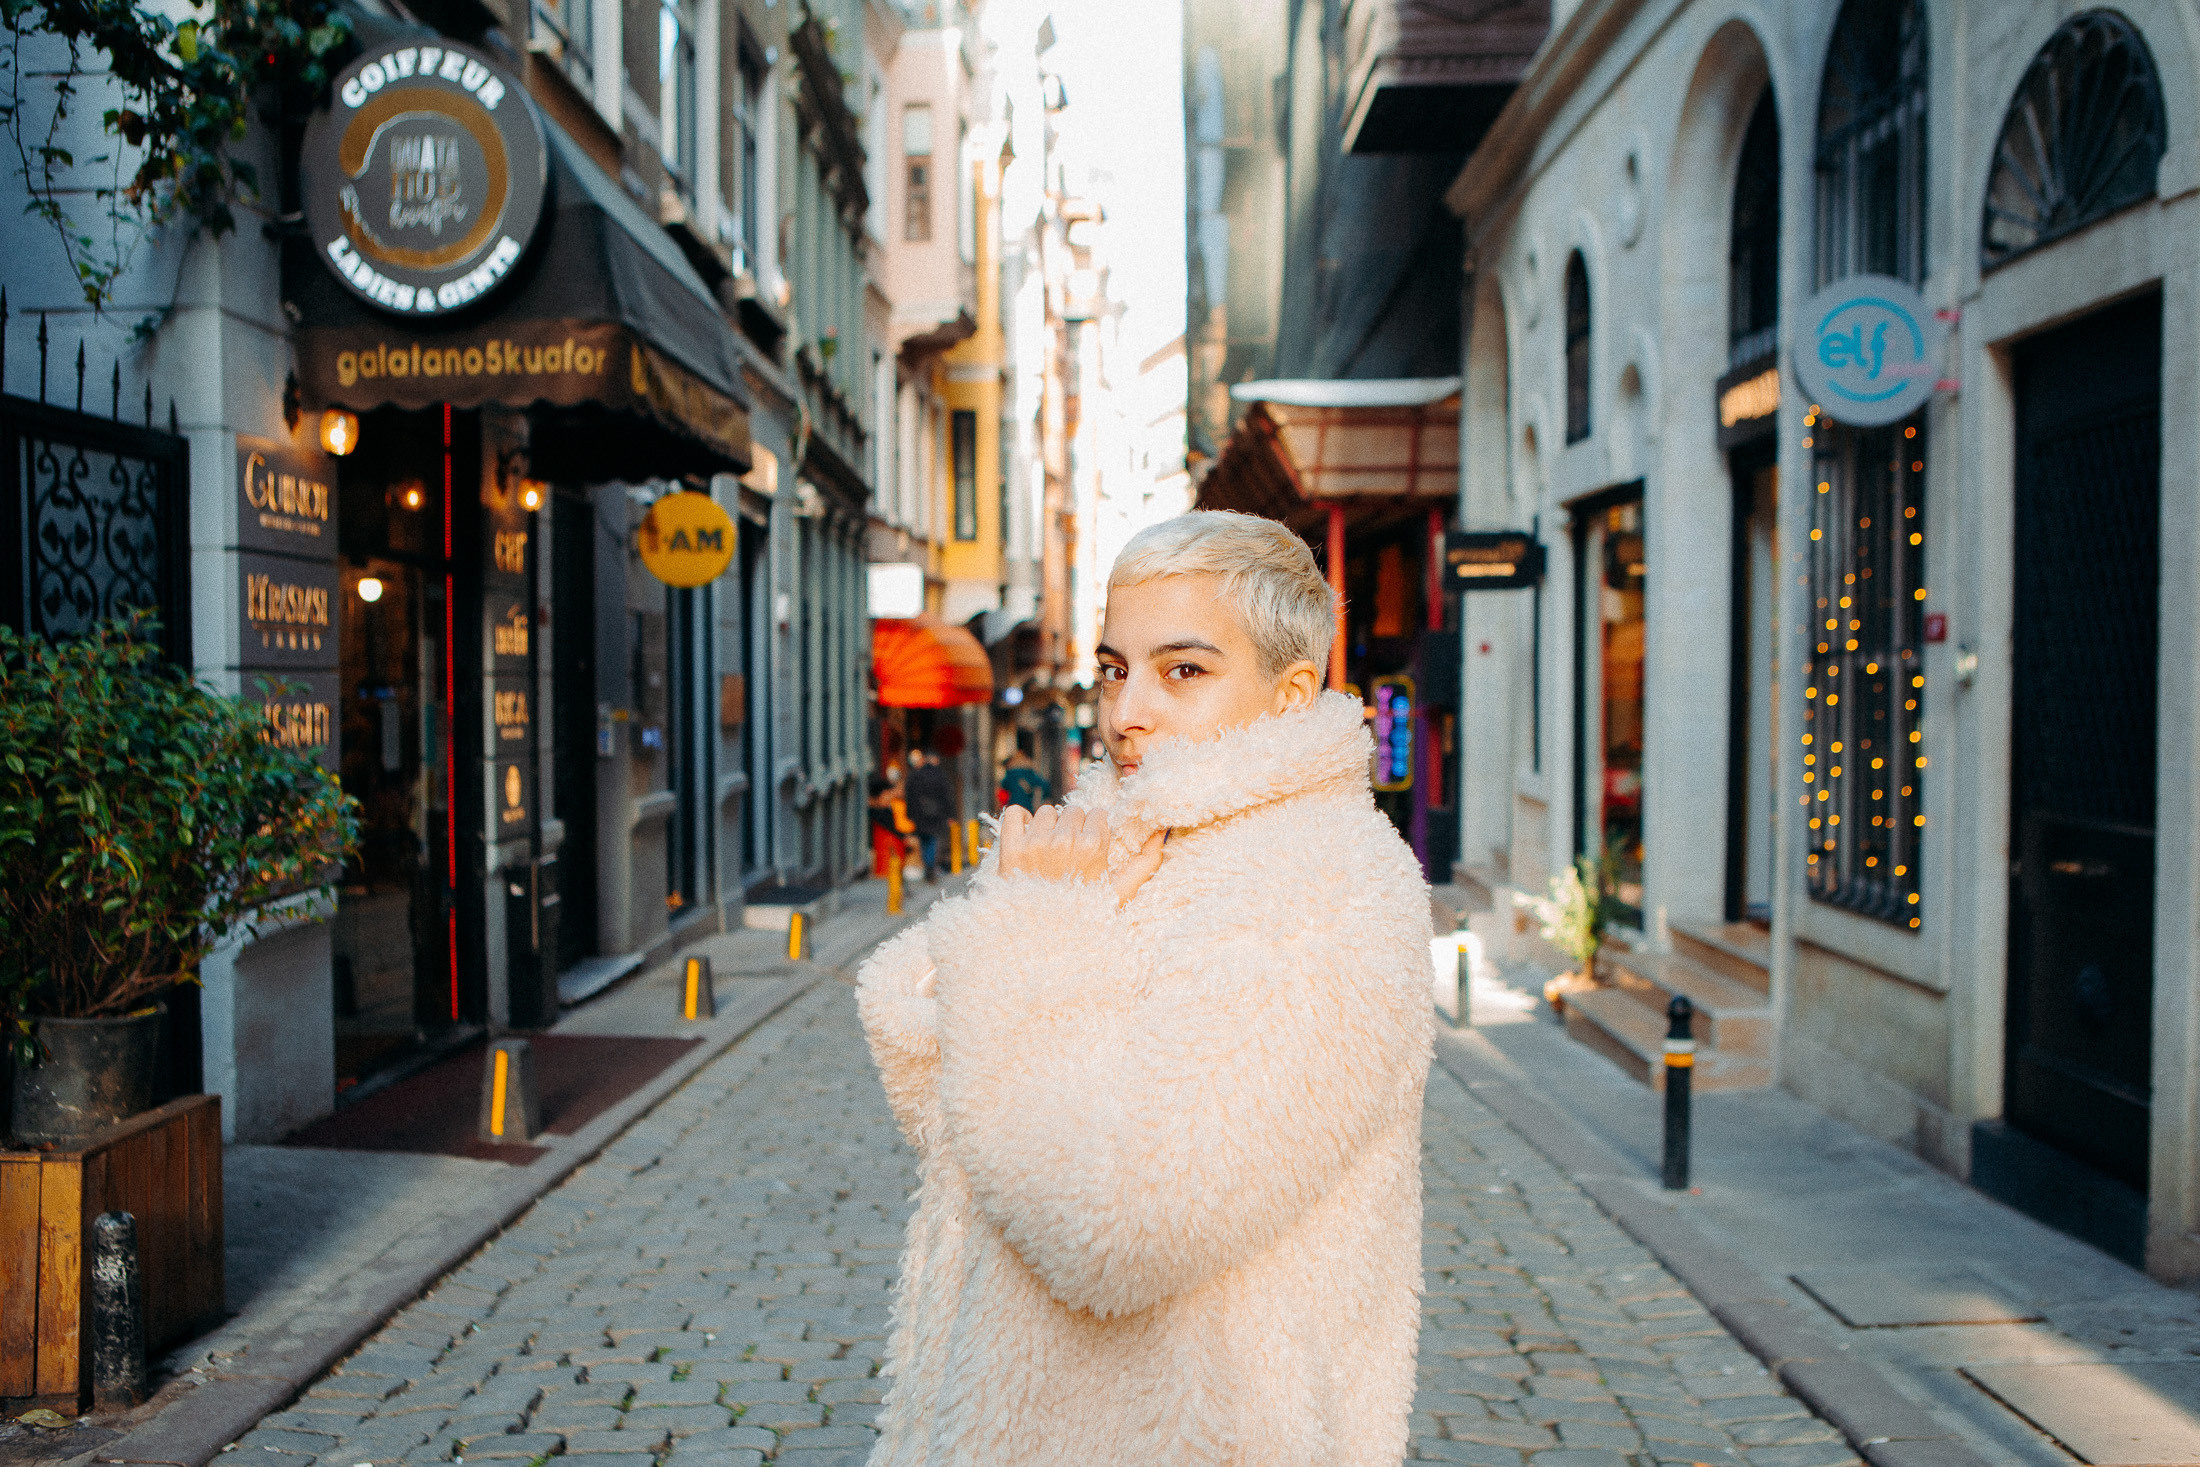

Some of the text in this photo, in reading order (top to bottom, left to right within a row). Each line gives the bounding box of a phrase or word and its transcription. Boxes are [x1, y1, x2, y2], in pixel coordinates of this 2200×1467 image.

[341, 46, 506, 111] COIFFEUR
[326, 234, 521, 313] LADIES & GENTS
